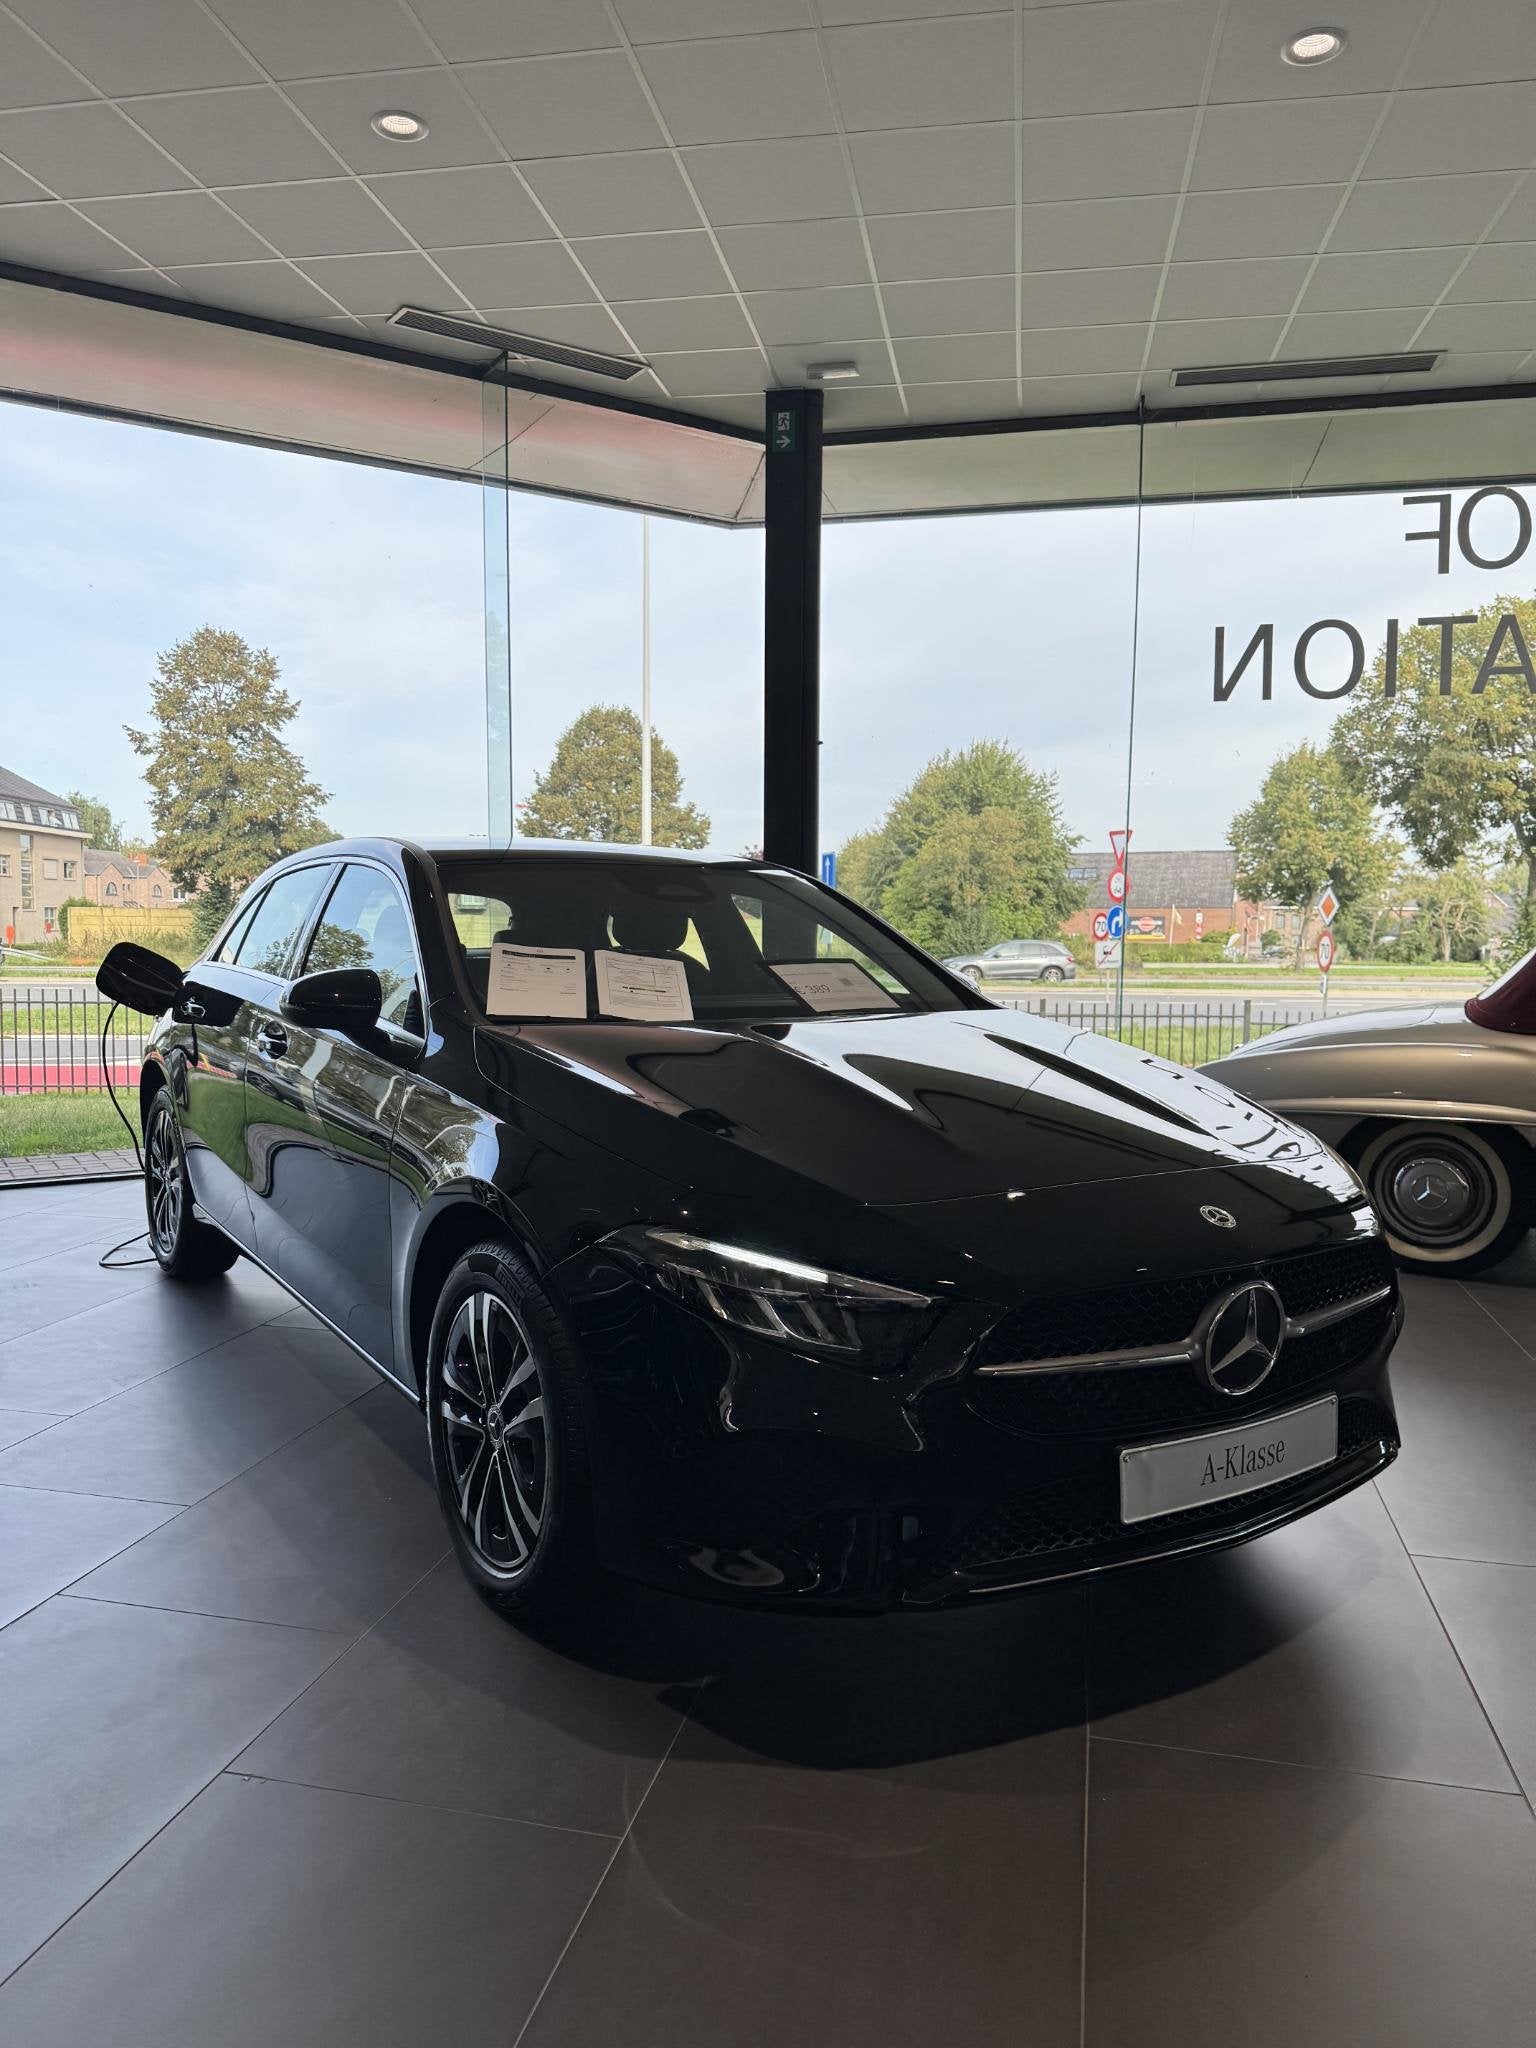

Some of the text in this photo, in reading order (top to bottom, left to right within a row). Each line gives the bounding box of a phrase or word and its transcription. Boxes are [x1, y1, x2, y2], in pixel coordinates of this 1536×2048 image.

[1096, 921, 1107, 933] 70
[1320, 943, 1330, 960] 70
[1200, 1440, 1285, 1486] A-Klasse
